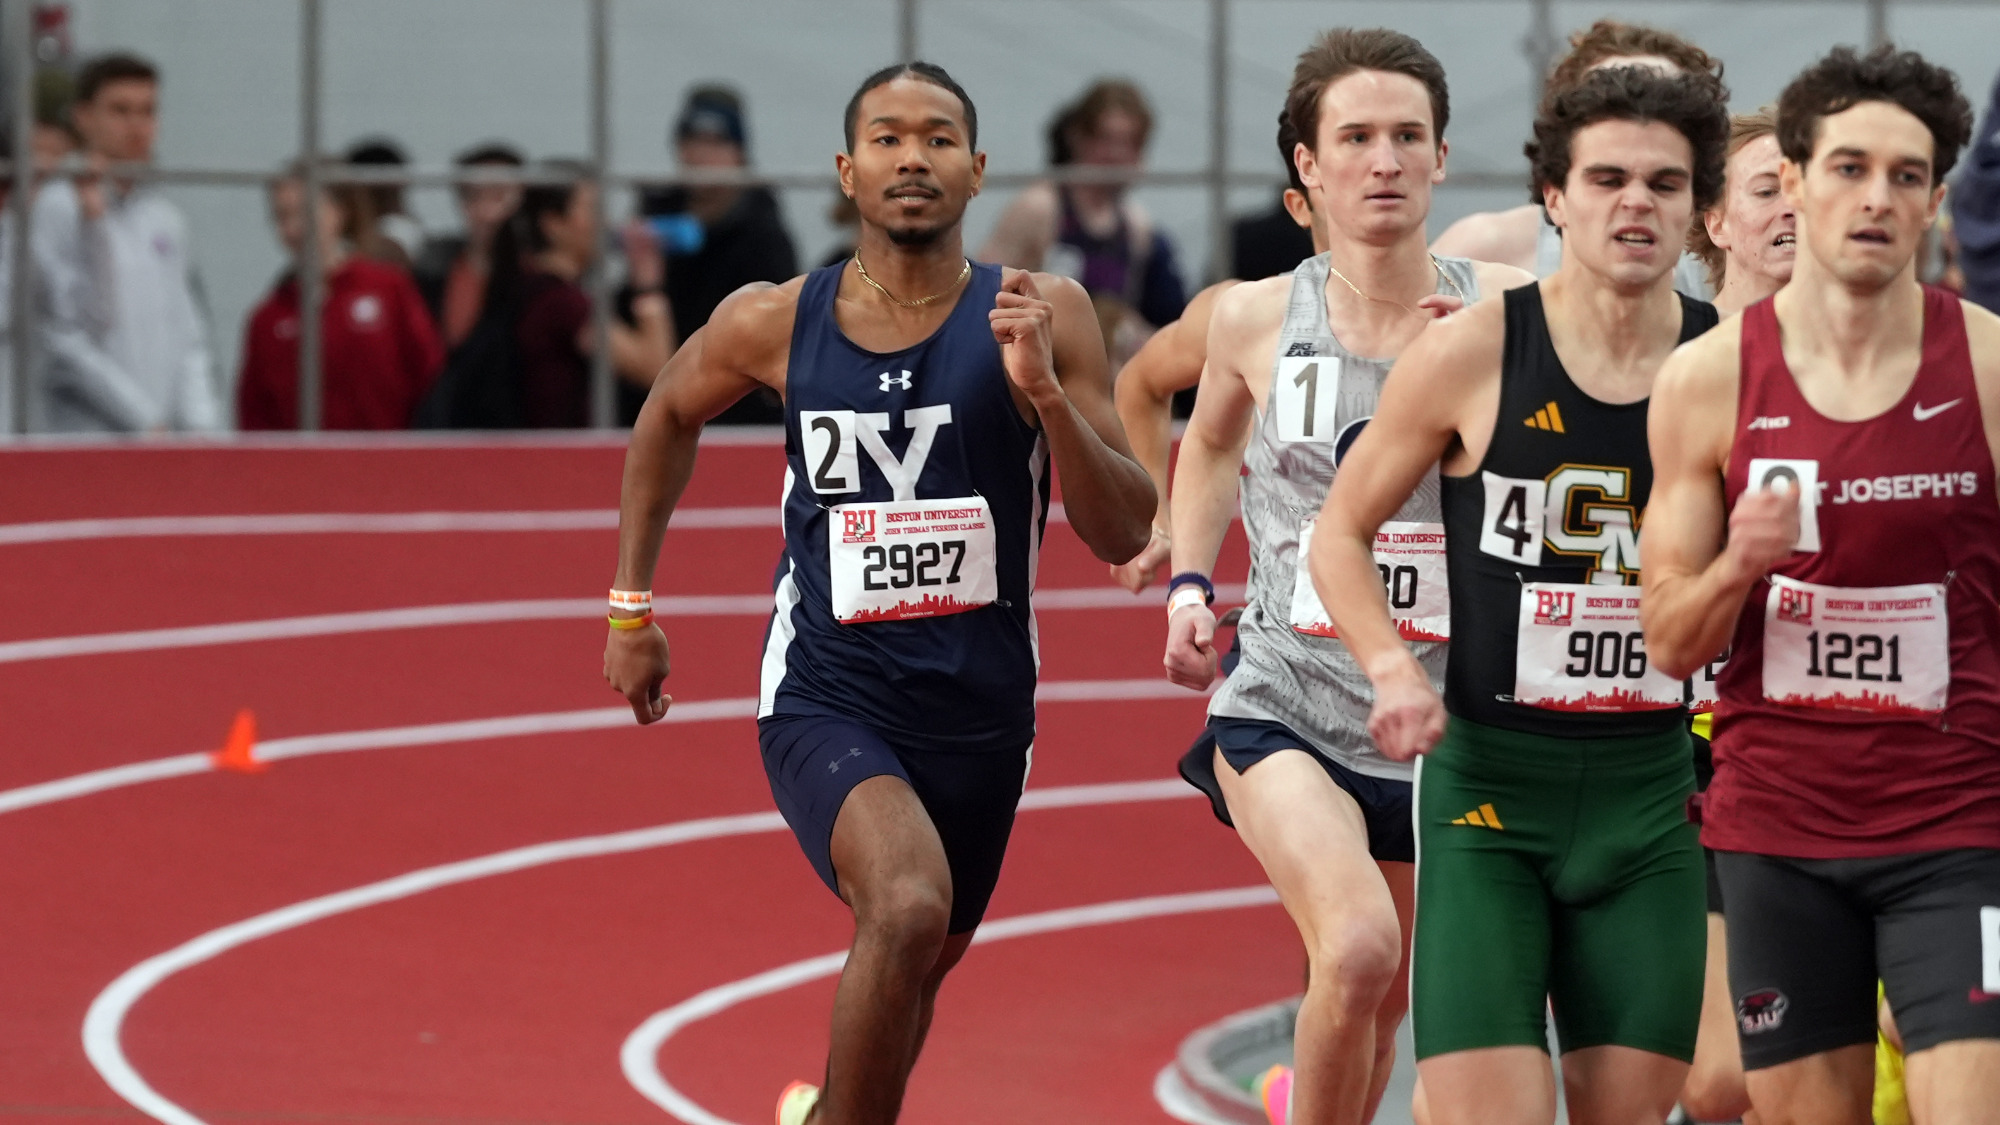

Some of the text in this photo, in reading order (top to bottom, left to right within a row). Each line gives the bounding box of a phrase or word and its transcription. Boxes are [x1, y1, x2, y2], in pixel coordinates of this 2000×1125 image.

[1290, 342, 1313, 350] BIG
[1294, 362, 1319, 437] 1
[811, 416, 846, 489] 2
[855, 404, 952, 502] Y
[1832, 471, 1978, 504] JOSEPH'S
[843, 509, 876, 536] BU
[884, 522, 986, 536] JOHN THOMAS TERRIER CLASSIC
[886, 508, 983, 523] BOSTON UNIVERSITY
[1494, 486, 1532, 557] 4
[1393, 533, 1446, 545] UNIVERSIT
[863, 540, 966, 591] 2927
[1535, 590, 1575, 619] BU
[1586, 597, 1623, 609] BOSTON
[1779, 586, 1815, 619] BU
[1868, 597, 1932, 611] UNIVERSITY
[1566, 631, 1646, 678] 906
[1807, 630, 1902, 682] 1221
[1743, 1010, 1778, 1031] SJU
